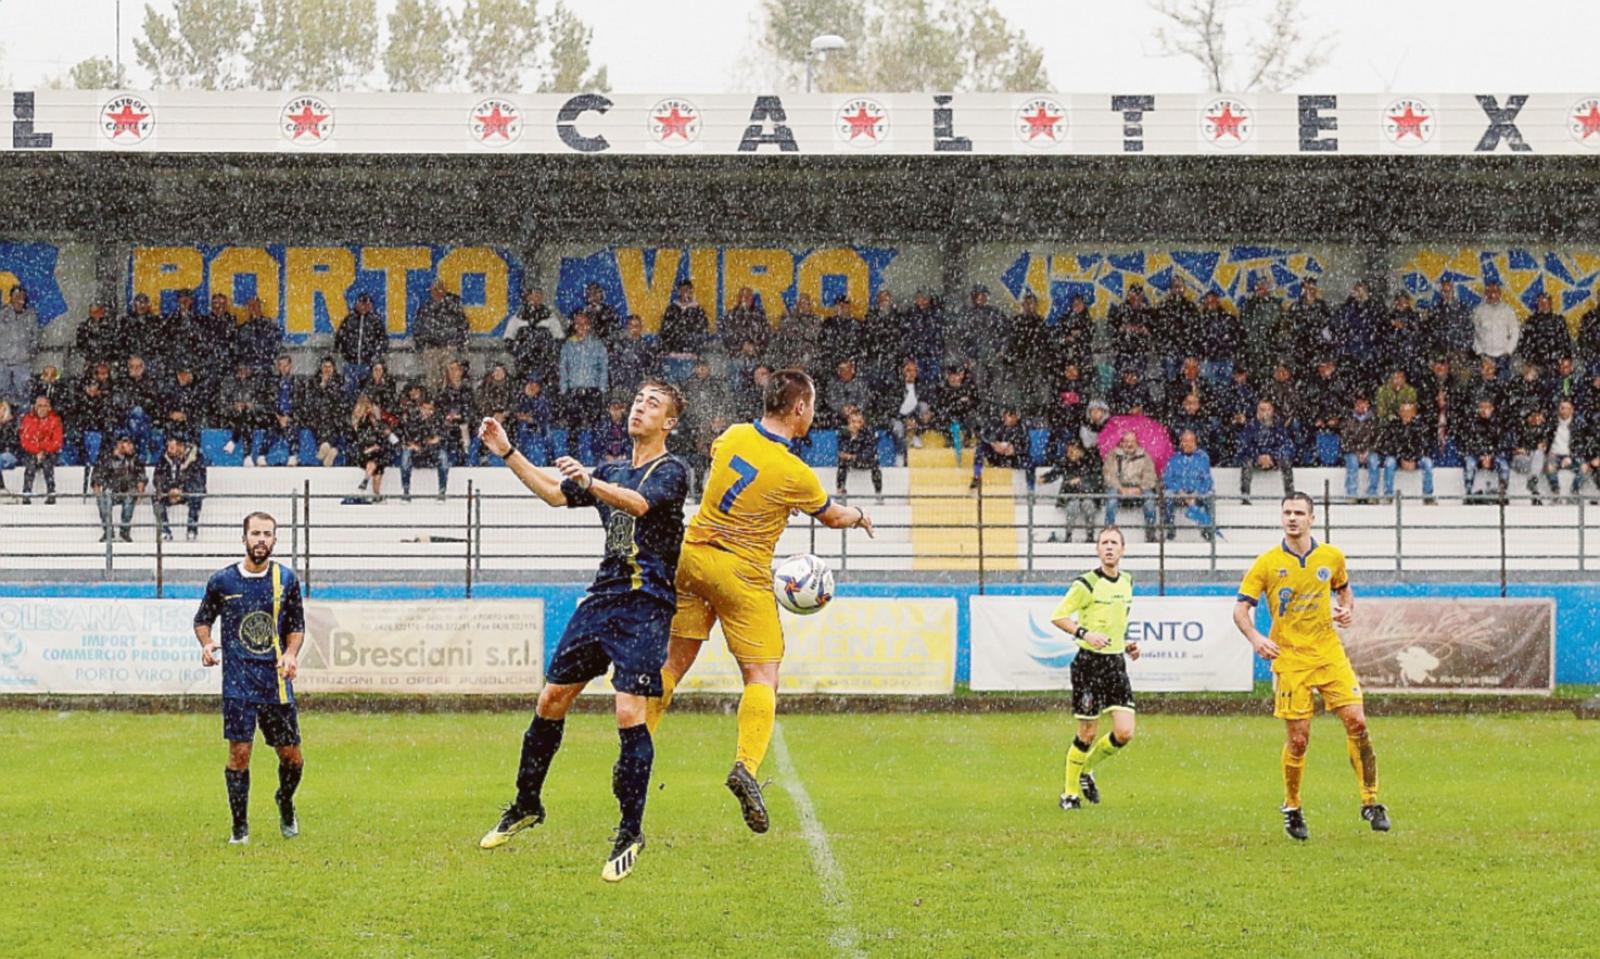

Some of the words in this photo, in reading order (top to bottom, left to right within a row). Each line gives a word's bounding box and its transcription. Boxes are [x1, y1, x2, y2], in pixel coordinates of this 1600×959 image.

[131, 246, 508, 334] PORTO
[614, 246, 870, 335] VIRO
[719, 454, 759, 515] 7
[143, 604, 193, 632] PES
[1124, 621, 1204, 642] ENTO
[42, 648, 127, 661] COMMERCIO
[82, 635, 137, 647] IMPORT
[153, 635, 197, 648] EXPOR
[333, 631, 472, 668] Bresciani
[486, 639, 538, 668] s.r.l.
[75, 667, 129, 682] PORTO
[135, 667, 173, 682] VIRO
